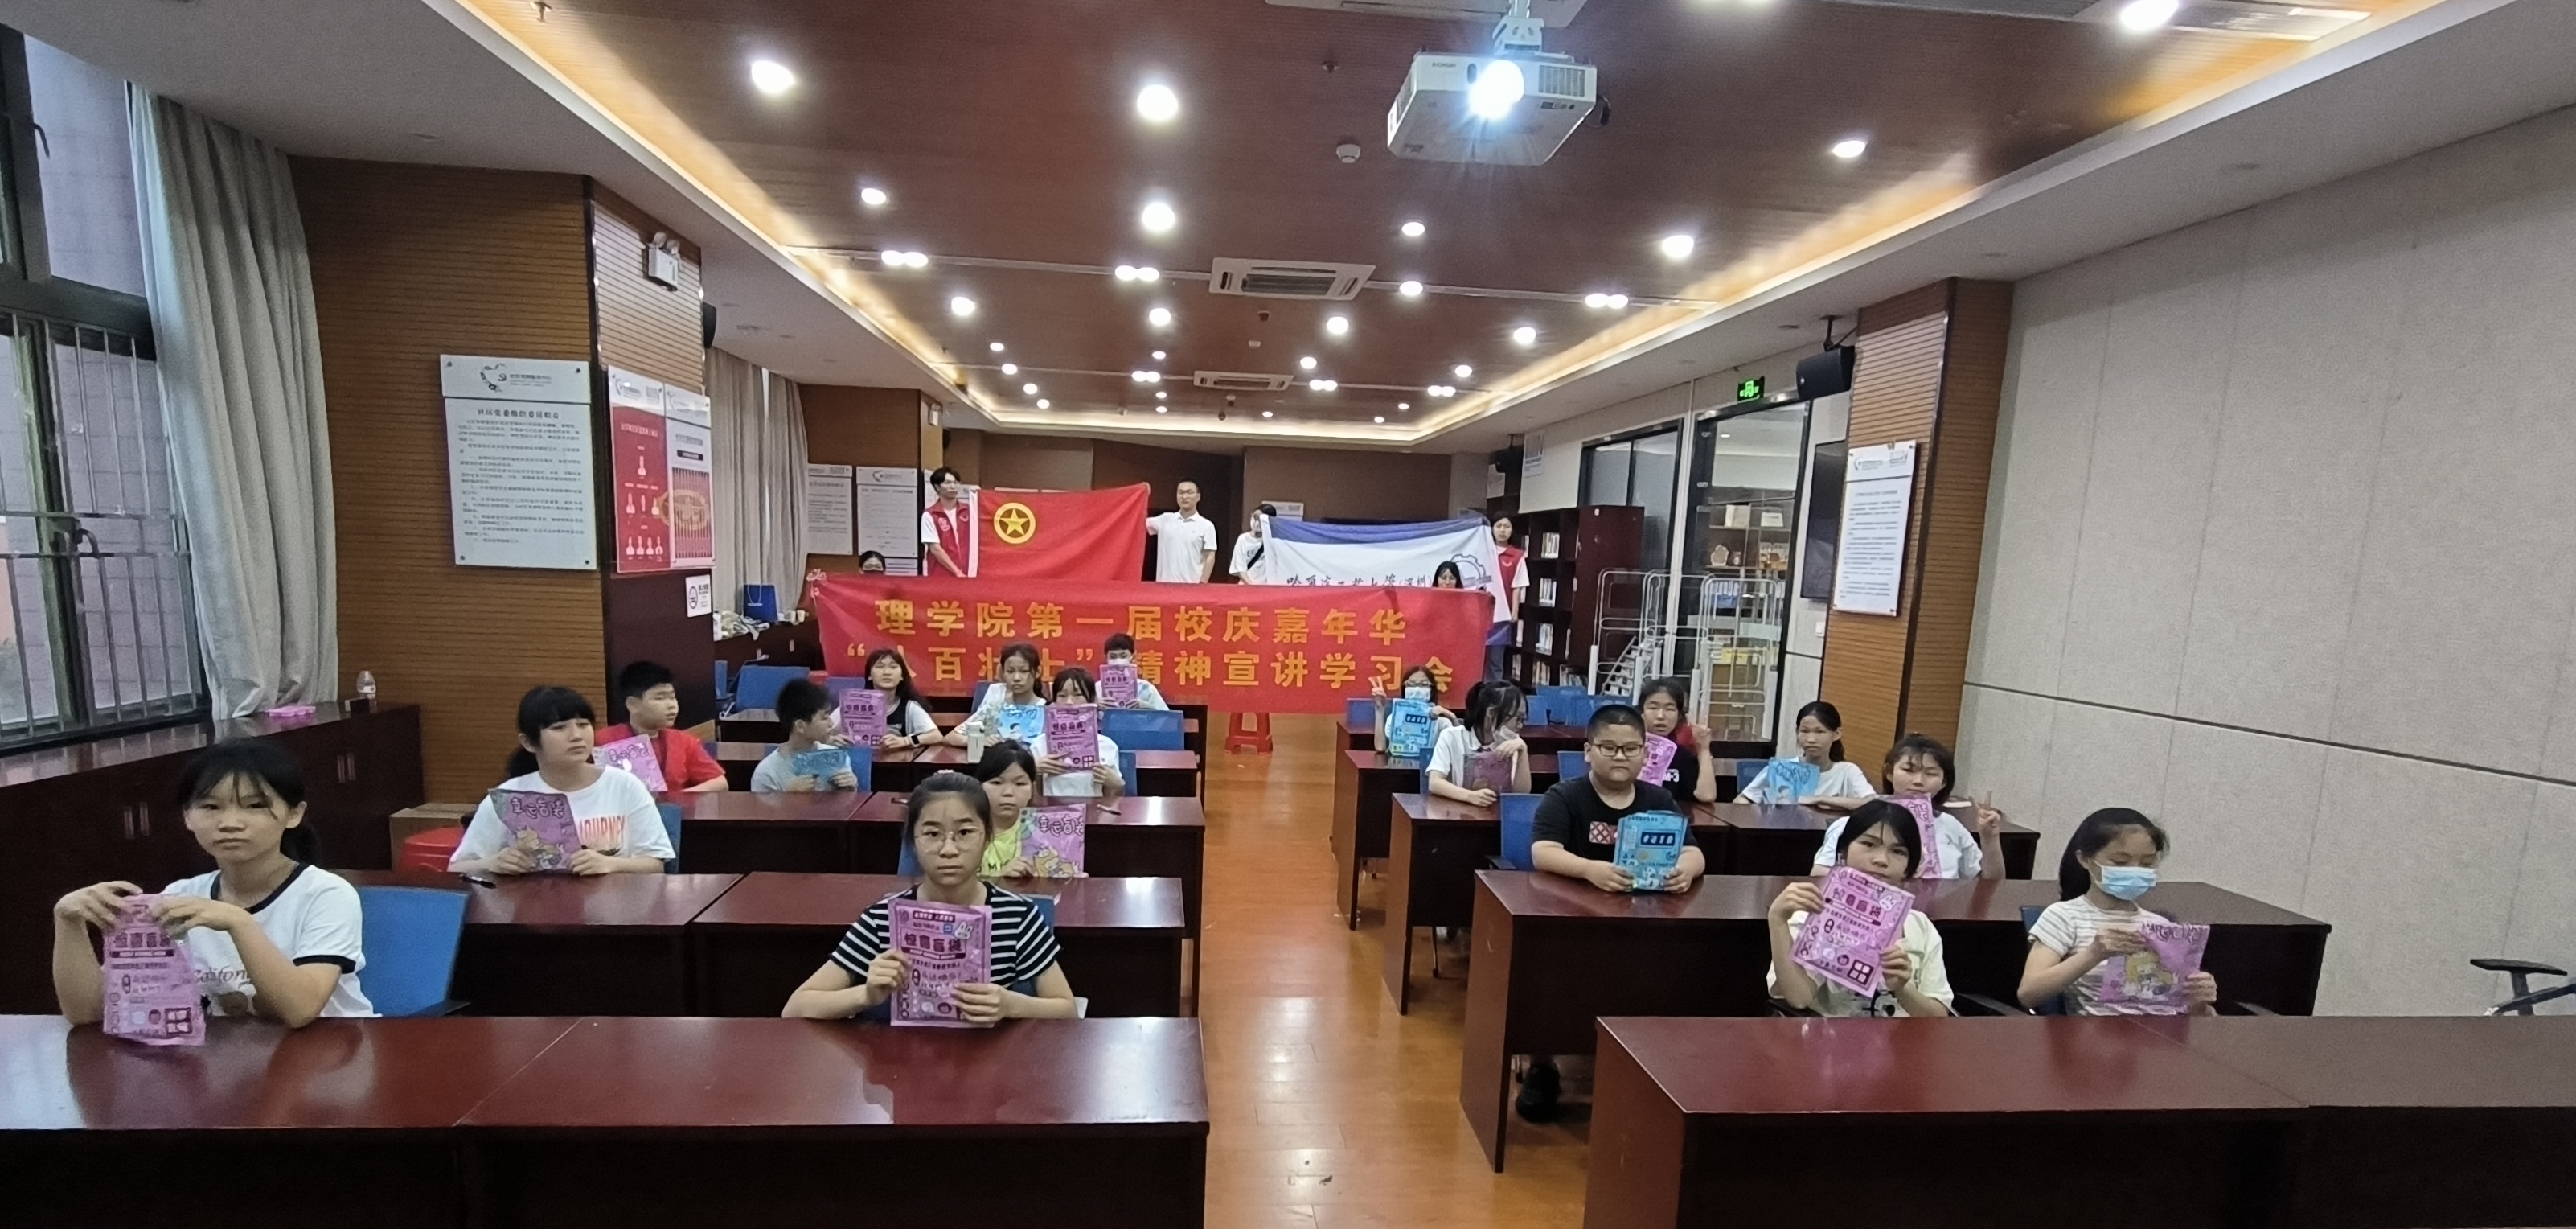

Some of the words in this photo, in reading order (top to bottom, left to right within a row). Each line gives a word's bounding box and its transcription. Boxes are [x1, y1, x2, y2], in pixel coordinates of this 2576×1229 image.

[875, 599, 1406, 646] 理学院第一届校庆嘉年华
